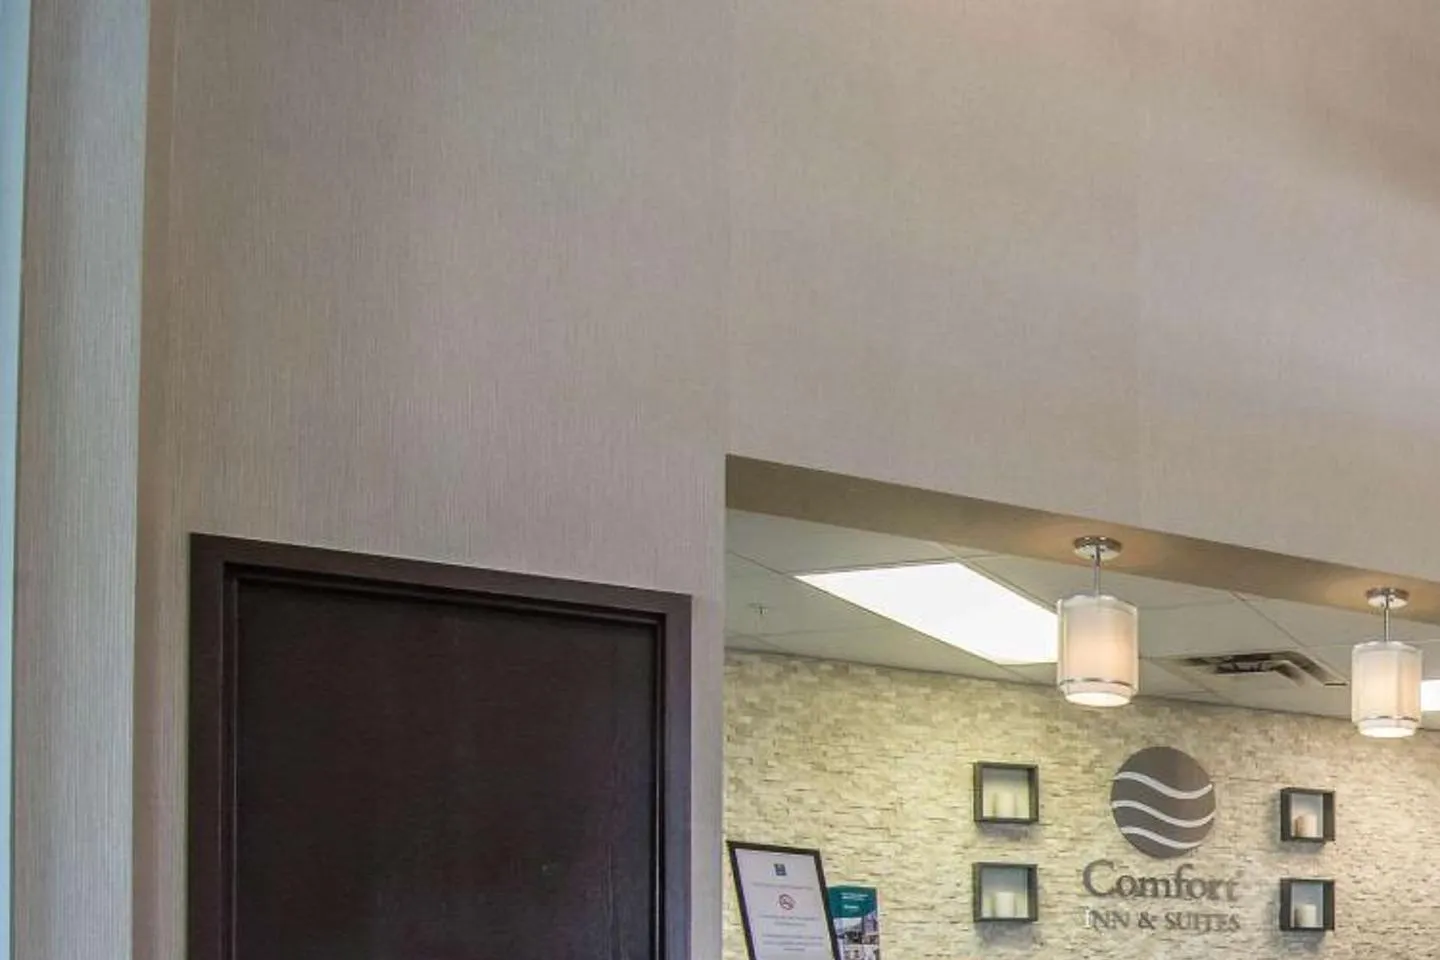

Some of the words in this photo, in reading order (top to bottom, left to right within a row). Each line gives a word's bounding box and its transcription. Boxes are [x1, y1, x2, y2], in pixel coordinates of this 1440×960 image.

[1082, 859, 1240, 901] Comfort
[1137, 911, 1157, 930] &
[1164, 911, 1241, 933] SUITES
